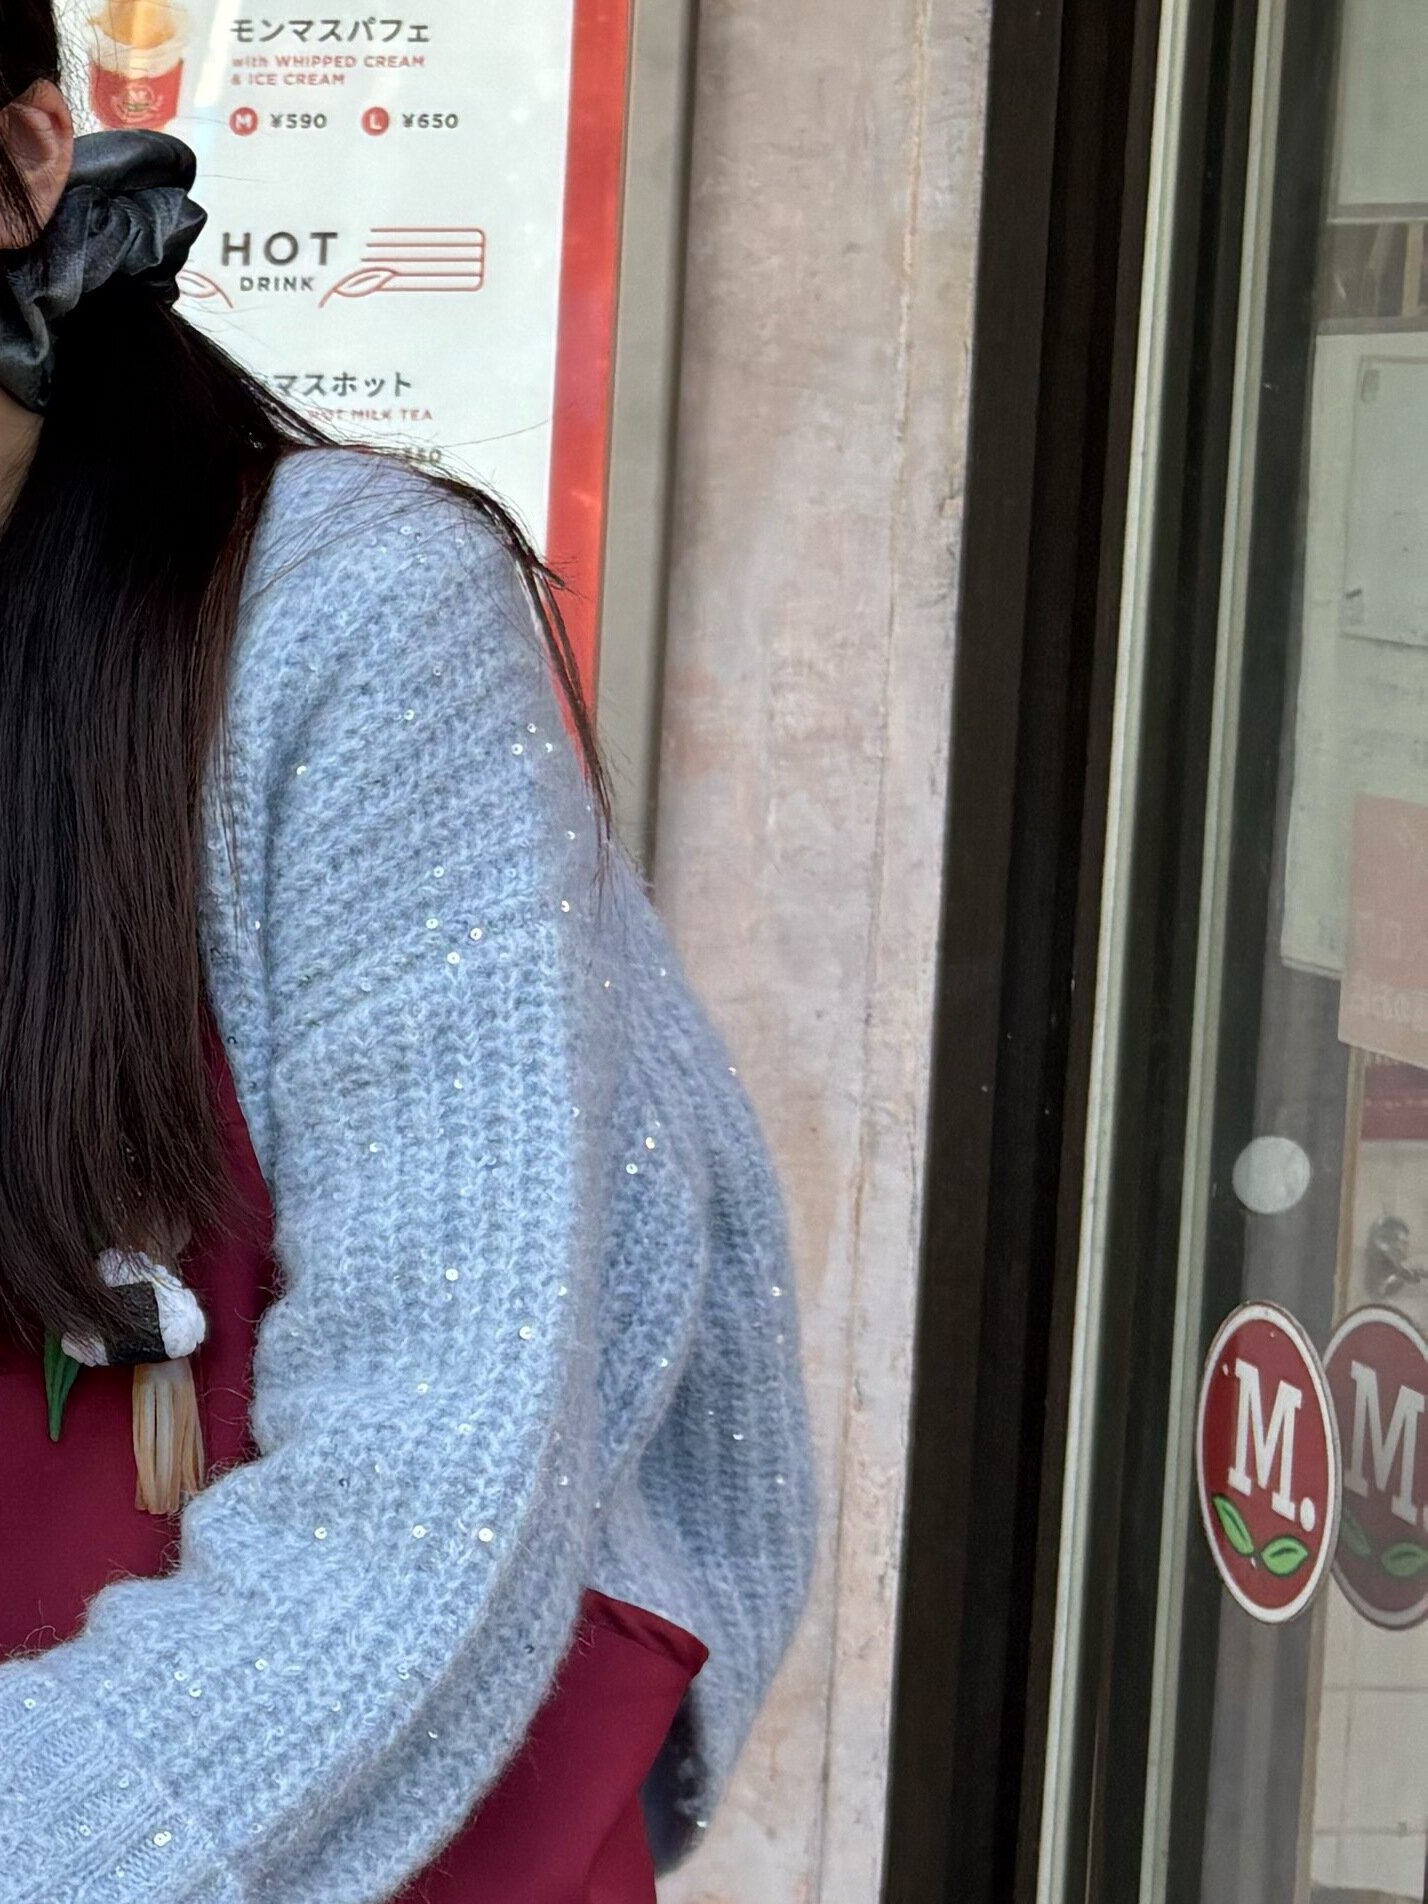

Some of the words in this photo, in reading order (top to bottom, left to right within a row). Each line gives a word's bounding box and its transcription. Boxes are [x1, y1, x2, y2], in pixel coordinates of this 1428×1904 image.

[230, 16, 431, 44] モンマスパフェ
[231, 55, 269, 68] with
[274, 55, 357, 69] WHIPPED
[362, 55, 426, 69] CREAM
[248, 73, 278, 86] ICE
[282, 73, 346, 86] CREAM
[268, 112, 329, 130] ¥590
[401, 112, 460, 130] ¥650
[219, 230, 340, 268] HOT
[238, 275, 317, 292] DRINK
[263, 370, 413, 398] マスホット
[399, 408, 434, 422] TEA
